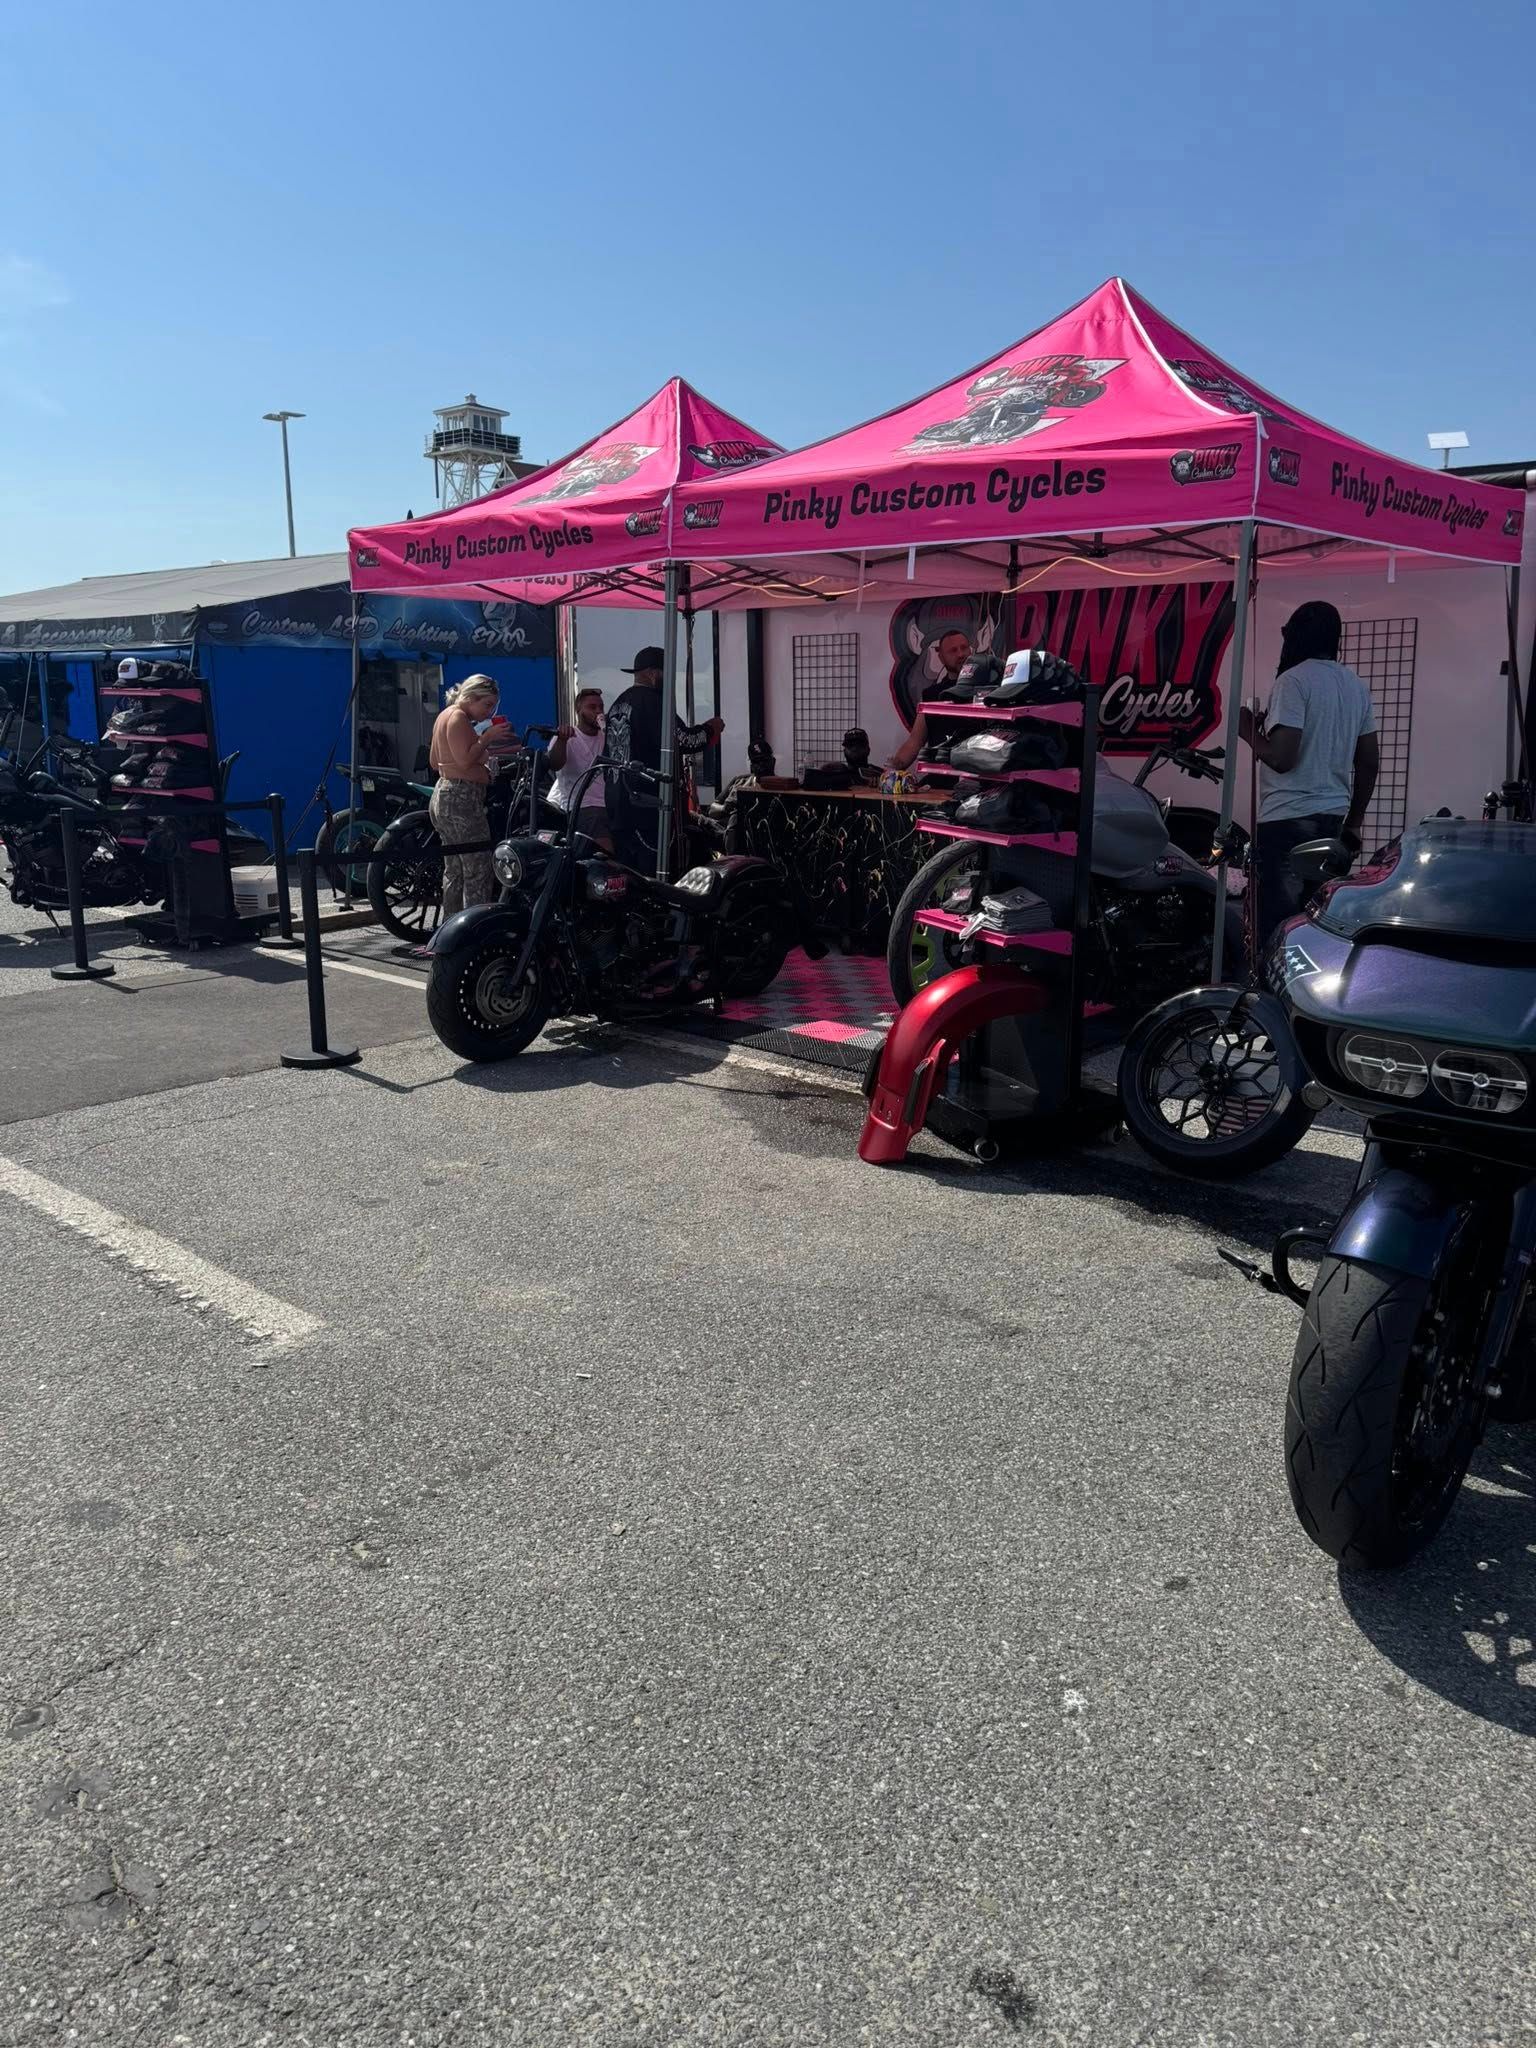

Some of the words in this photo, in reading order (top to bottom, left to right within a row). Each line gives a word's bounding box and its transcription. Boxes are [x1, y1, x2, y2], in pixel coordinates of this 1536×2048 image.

[1194, 446, 1240, 468] PINKY
[763, 487, 842, 529] Pinky
[850, 480, 976, 516] Custom
[986, 460, 1106, 514] Cycles
[1331, 461, 1379, 518] Pinky
[1381, 475, 1442, 521] Custom
[1442, 494, 1489, 535] Cycles
[403, 538, 450, 569] Pinky
[456, 530, 526, 560] Custom
[528, 519, 593, 558] Cycles
[24, 623, 135, 646] Accessories
[242, 611, 319, 636] Custom
[384, 616, 459, 647] Lighting
[1015, 581, 1229, 684] PINKY
[1099, 675, 1200, 734] Cycles
